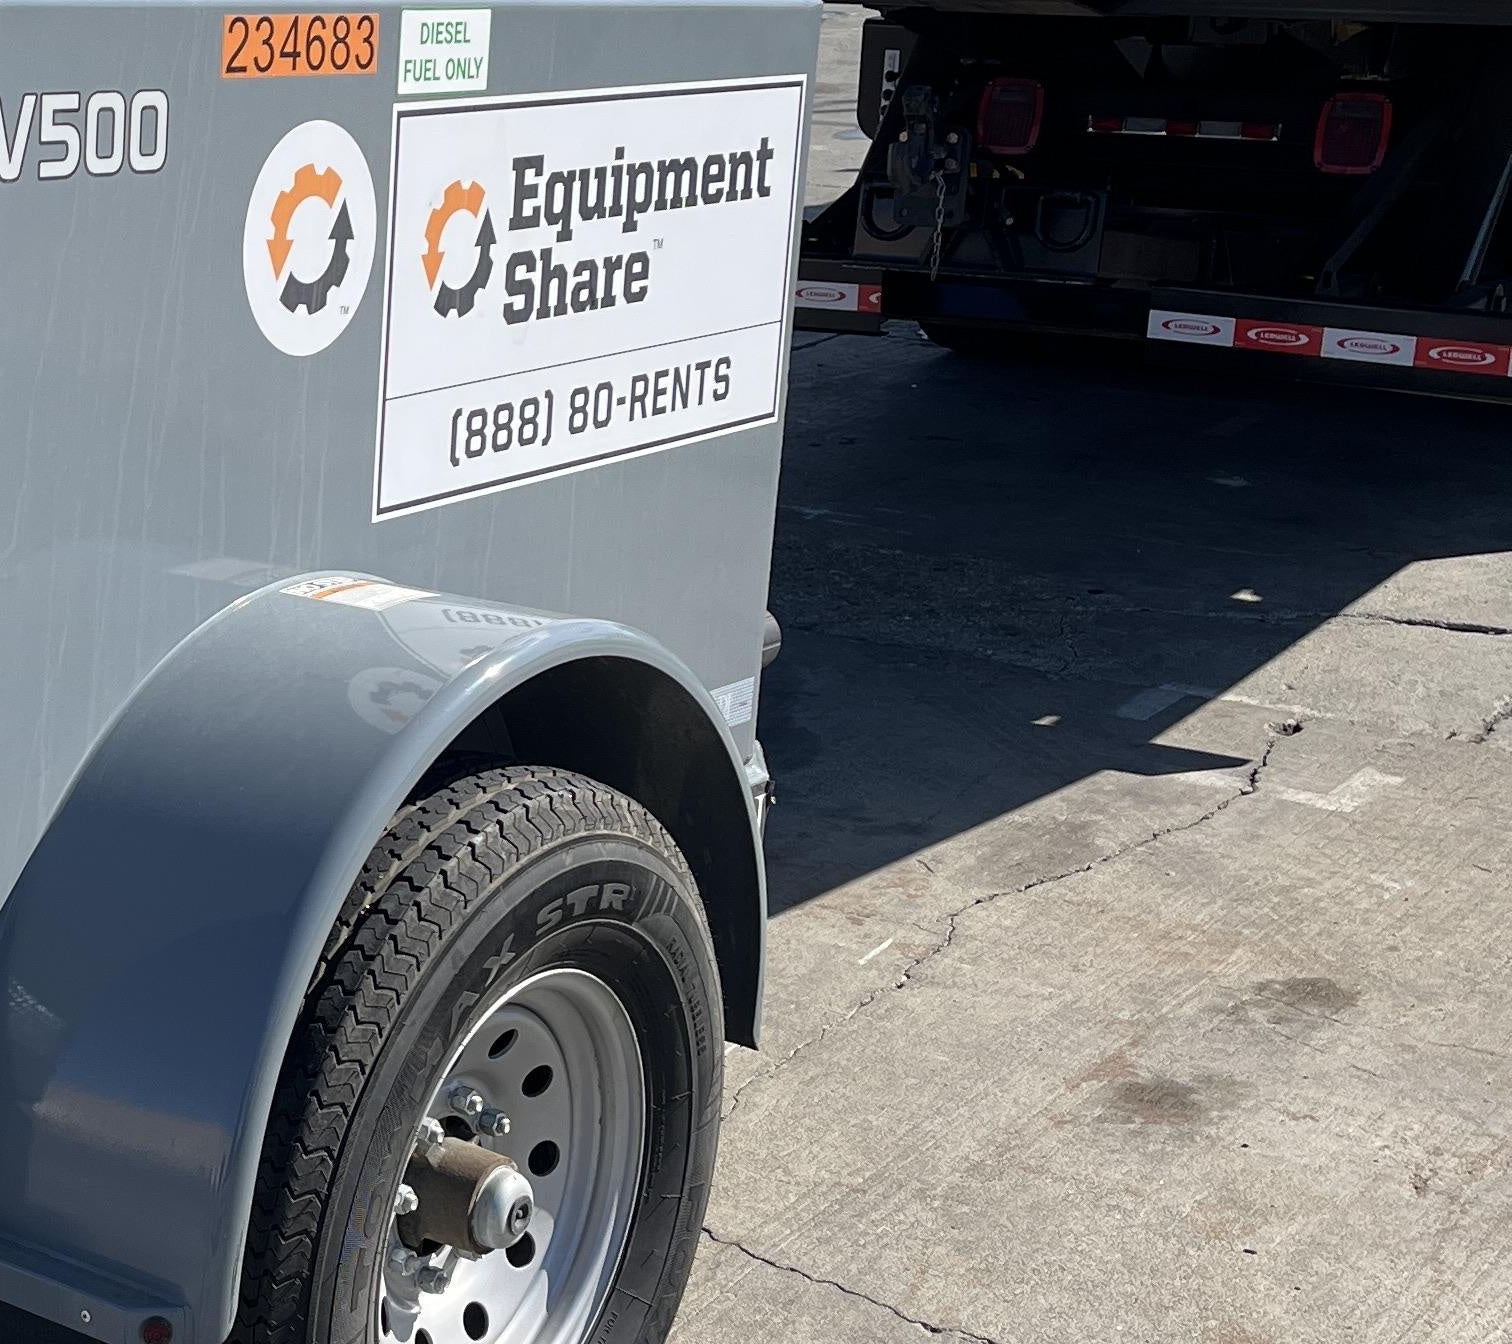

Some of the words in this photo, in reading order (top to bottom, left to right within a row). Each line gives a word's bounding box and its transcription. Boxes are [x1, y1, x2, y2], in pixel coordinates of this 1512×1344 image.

[226, 15, 375, 74] 234683
[420, 21, 471, 46] DIESEL
[403, 57, 441, 83] FUEL
[445, 55, 483, 81] ONLY
[508, 136, 775, 243] Equipment
[502, 247, 650, 325] Share
[450, 389, 554, 467] (888)
[568, 356, 731, 435] 80-RENTS
[535, 883, 631, 936] STR
